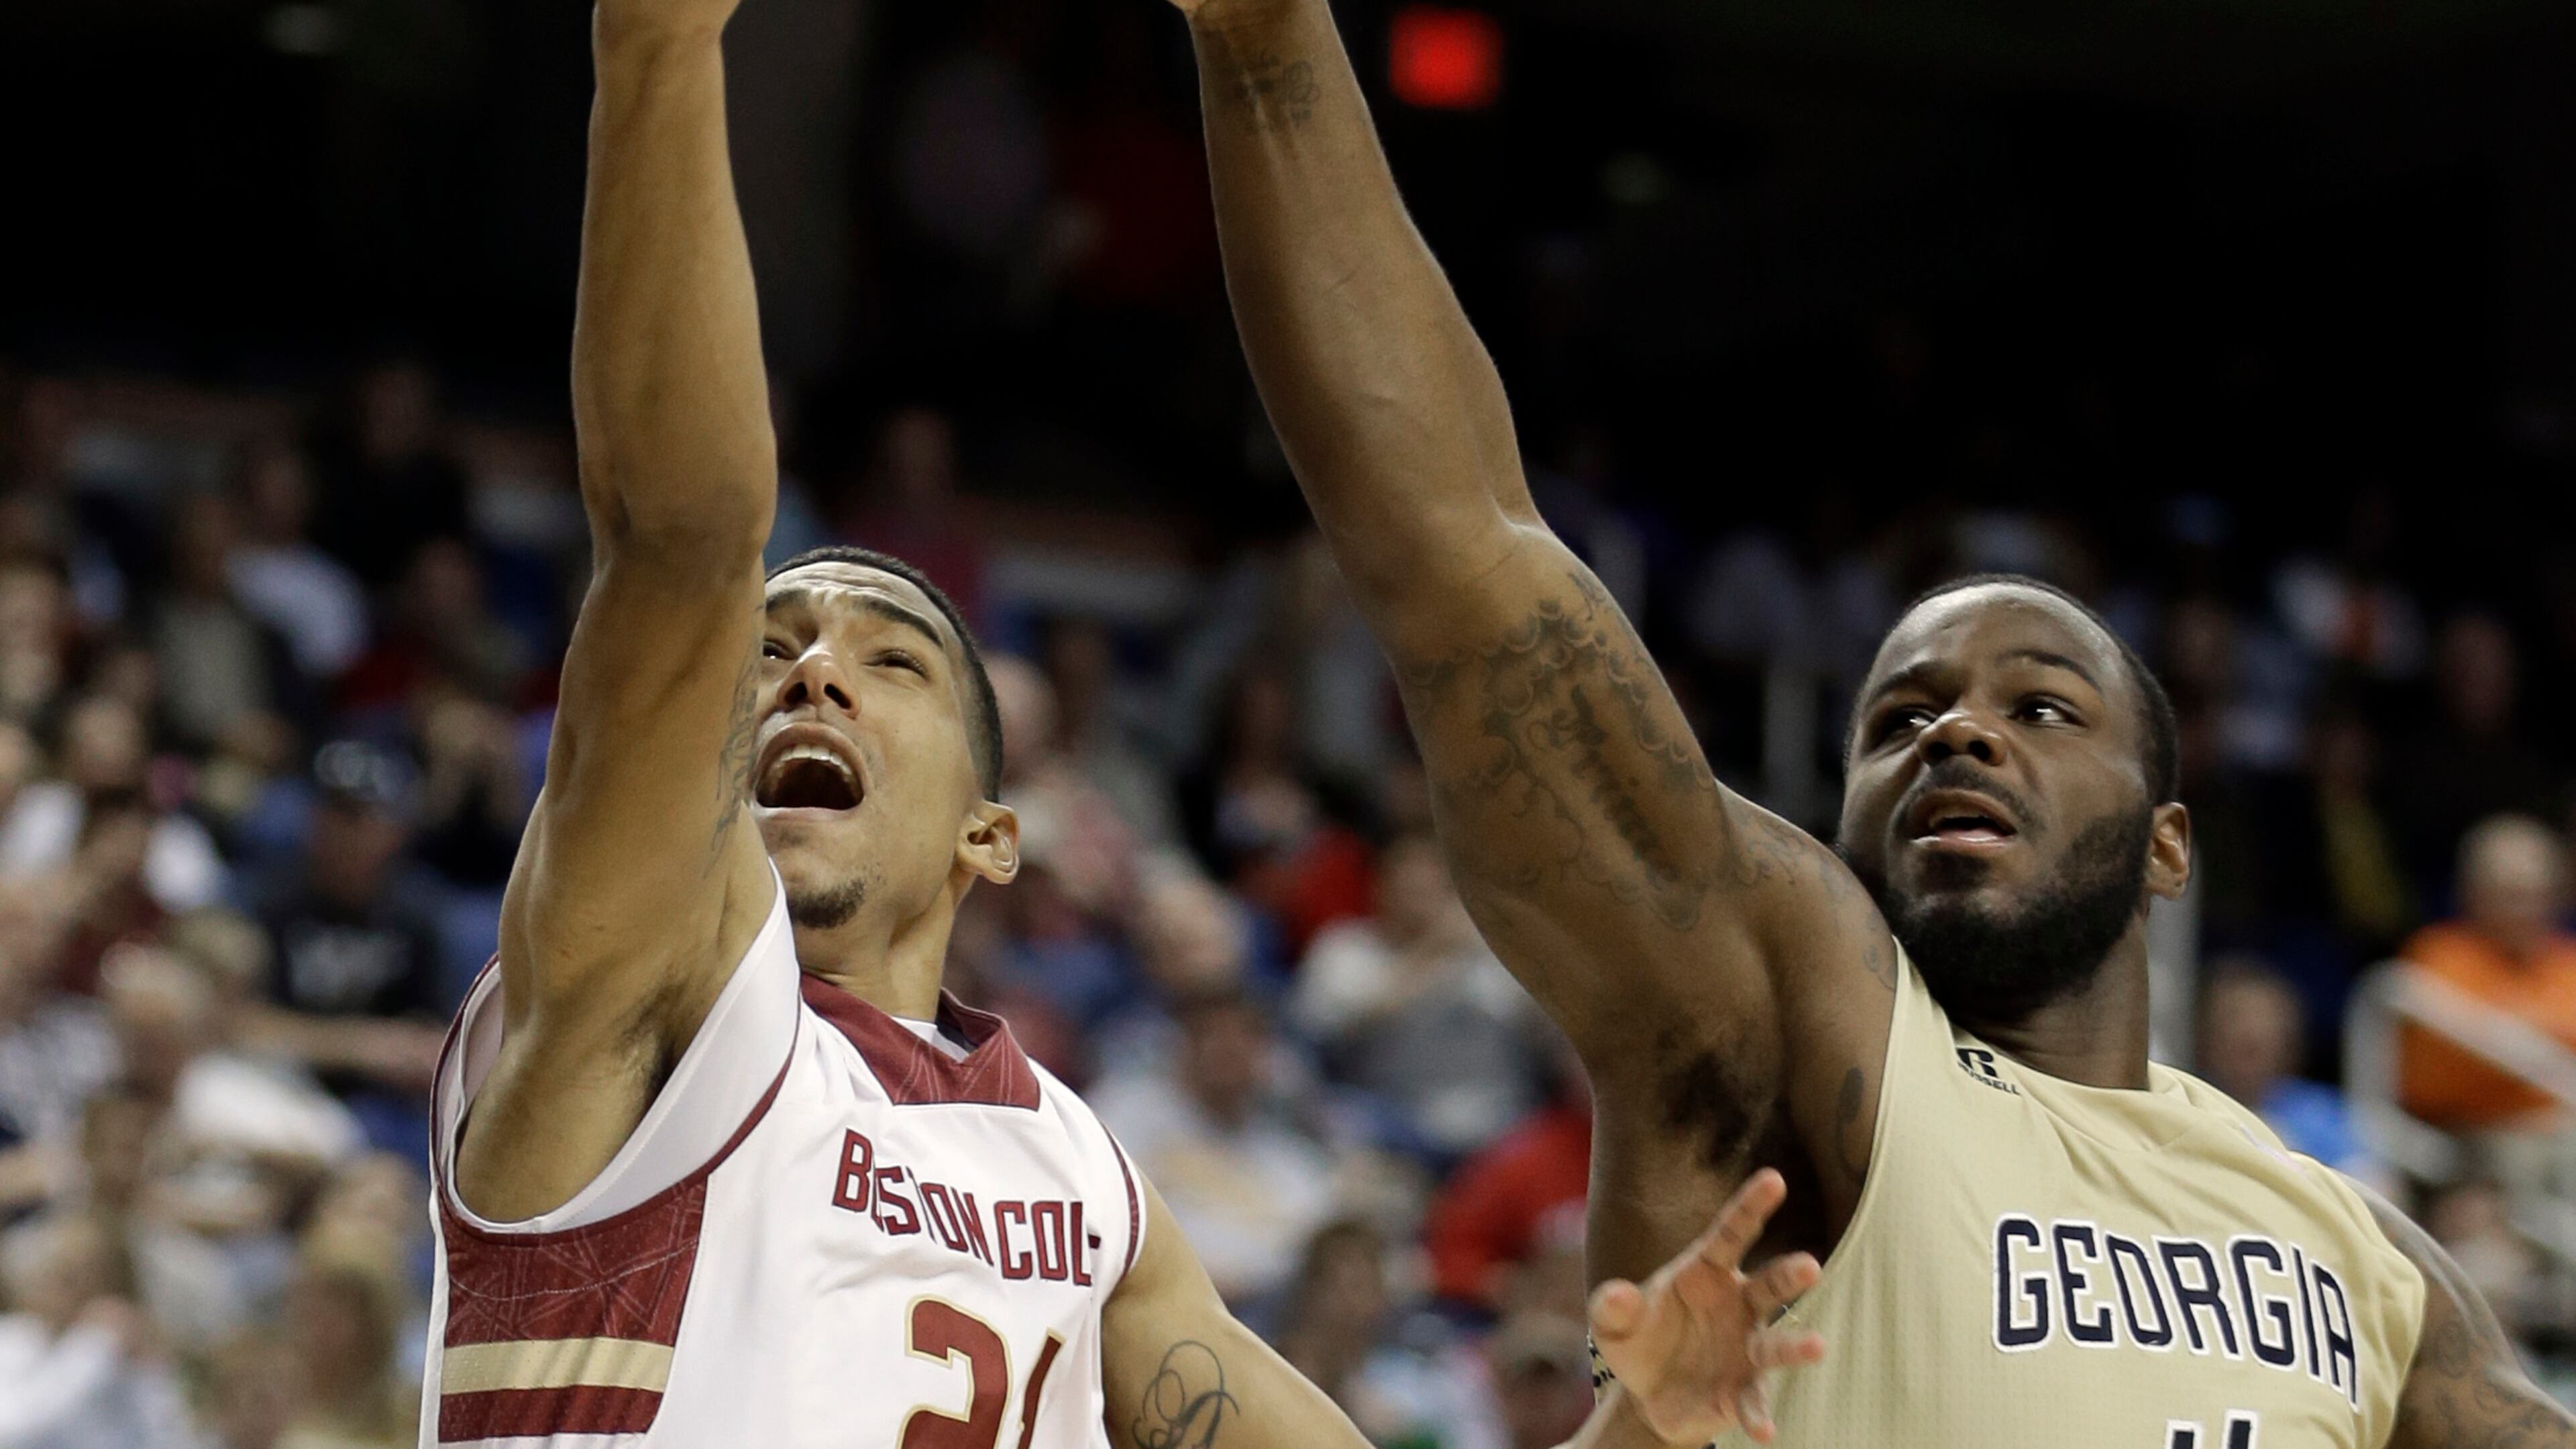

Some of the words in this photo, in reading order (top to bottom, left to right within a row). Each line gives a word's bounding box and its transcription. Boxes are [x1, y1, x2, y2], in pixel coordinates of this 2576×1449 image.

[833, 1128, 994, 1267] BSON
[994, 1201, 1101, 1286] COL
[1993, 1214, 2359, 1412] GEORGIA
